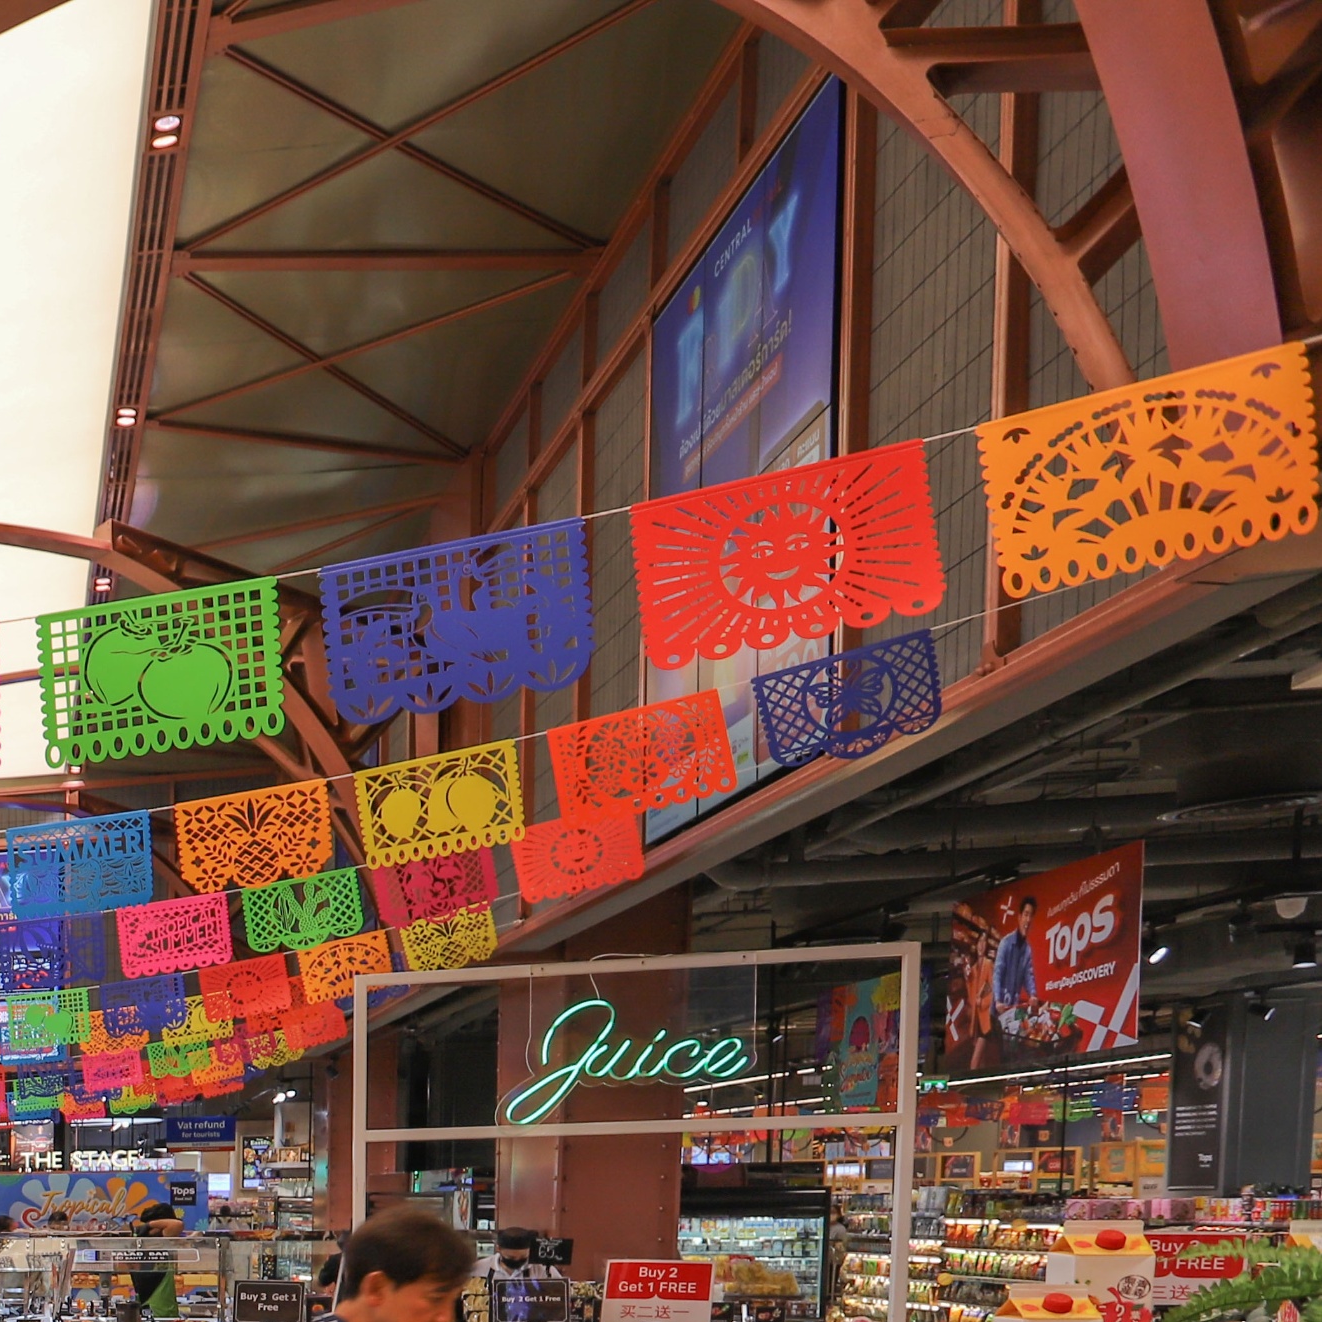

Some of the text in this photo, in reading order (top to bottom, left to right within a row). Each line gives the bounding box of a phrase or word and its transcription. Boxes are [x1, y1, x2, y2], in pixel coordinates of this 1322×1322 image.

[713, 218, 752, 278] CENTRAL
[17, 830, 142, 867] SUMMER
[150, 906, 217, 941] TROPICAL
[1045, 893, 1115, 967] Tops
[506, 999, 748, 1125] Juice
[177, 1120, 226, 1129] Vat refund
[193, 1130, 221, 1138] tourists
[21, 1149, 138, 1169] THE STAGE
[171, 1186, 196, 1197] Tops
[39, 1186, 127, 1221] Tropical
[1150, 1239, 1184, 1253] Buy
[1176, 1256, 1226, 1271] FREE
[638, 1267, 678, 1280] Buy 2
[618, 1281, 697, 1293] Get 1 FREE
[240, 1292, 257, 1301] Buy
[260, 1292, 267, 1301] 3
[271, 1292, 289, 1301] Get
[257, 1302, 279, 1311] Free
[620, 1304, 690, 1319] 买二送一
